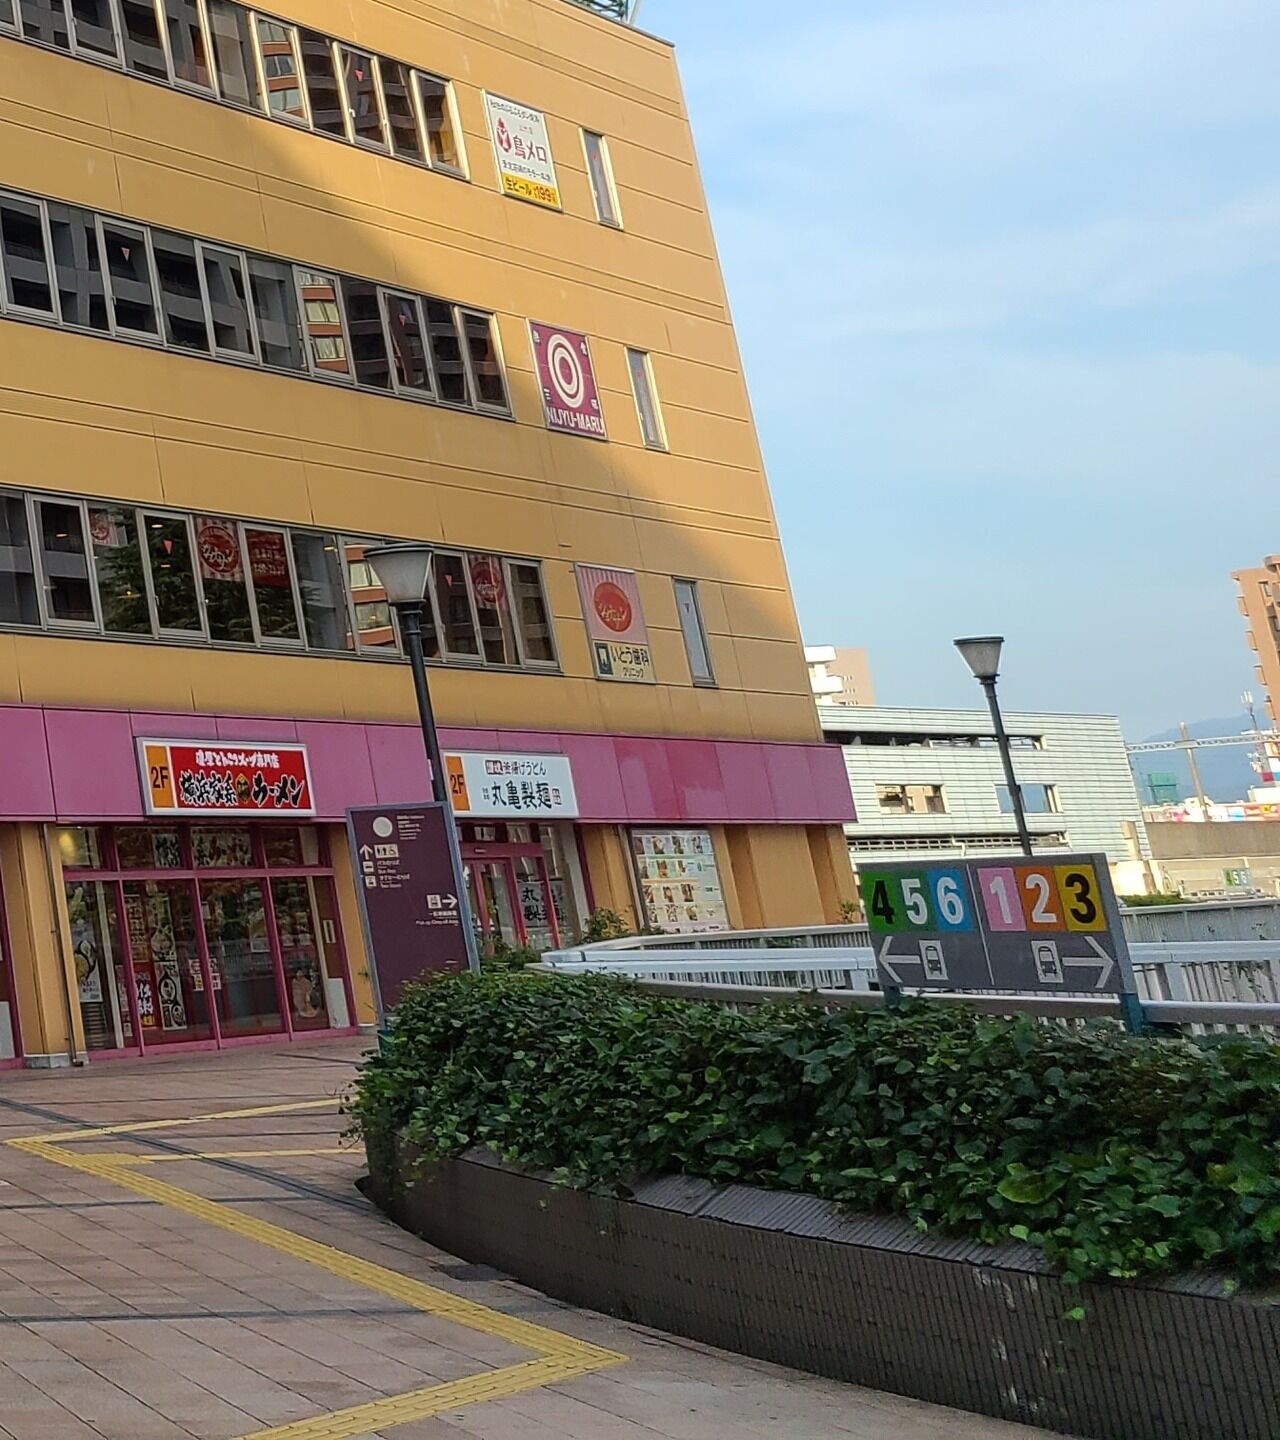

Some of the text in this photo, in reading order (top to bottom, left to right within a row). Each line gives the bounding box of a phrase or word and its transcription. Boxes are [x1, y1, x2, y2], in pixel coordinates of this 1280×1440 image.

[150, 766, 169, 789] 2F
[449, 774, 465, 795] 2F
[491, 779, 553, 810] 丸亀製麺
[871, 872, 1097, 925] 4 5 6 1 2 3
